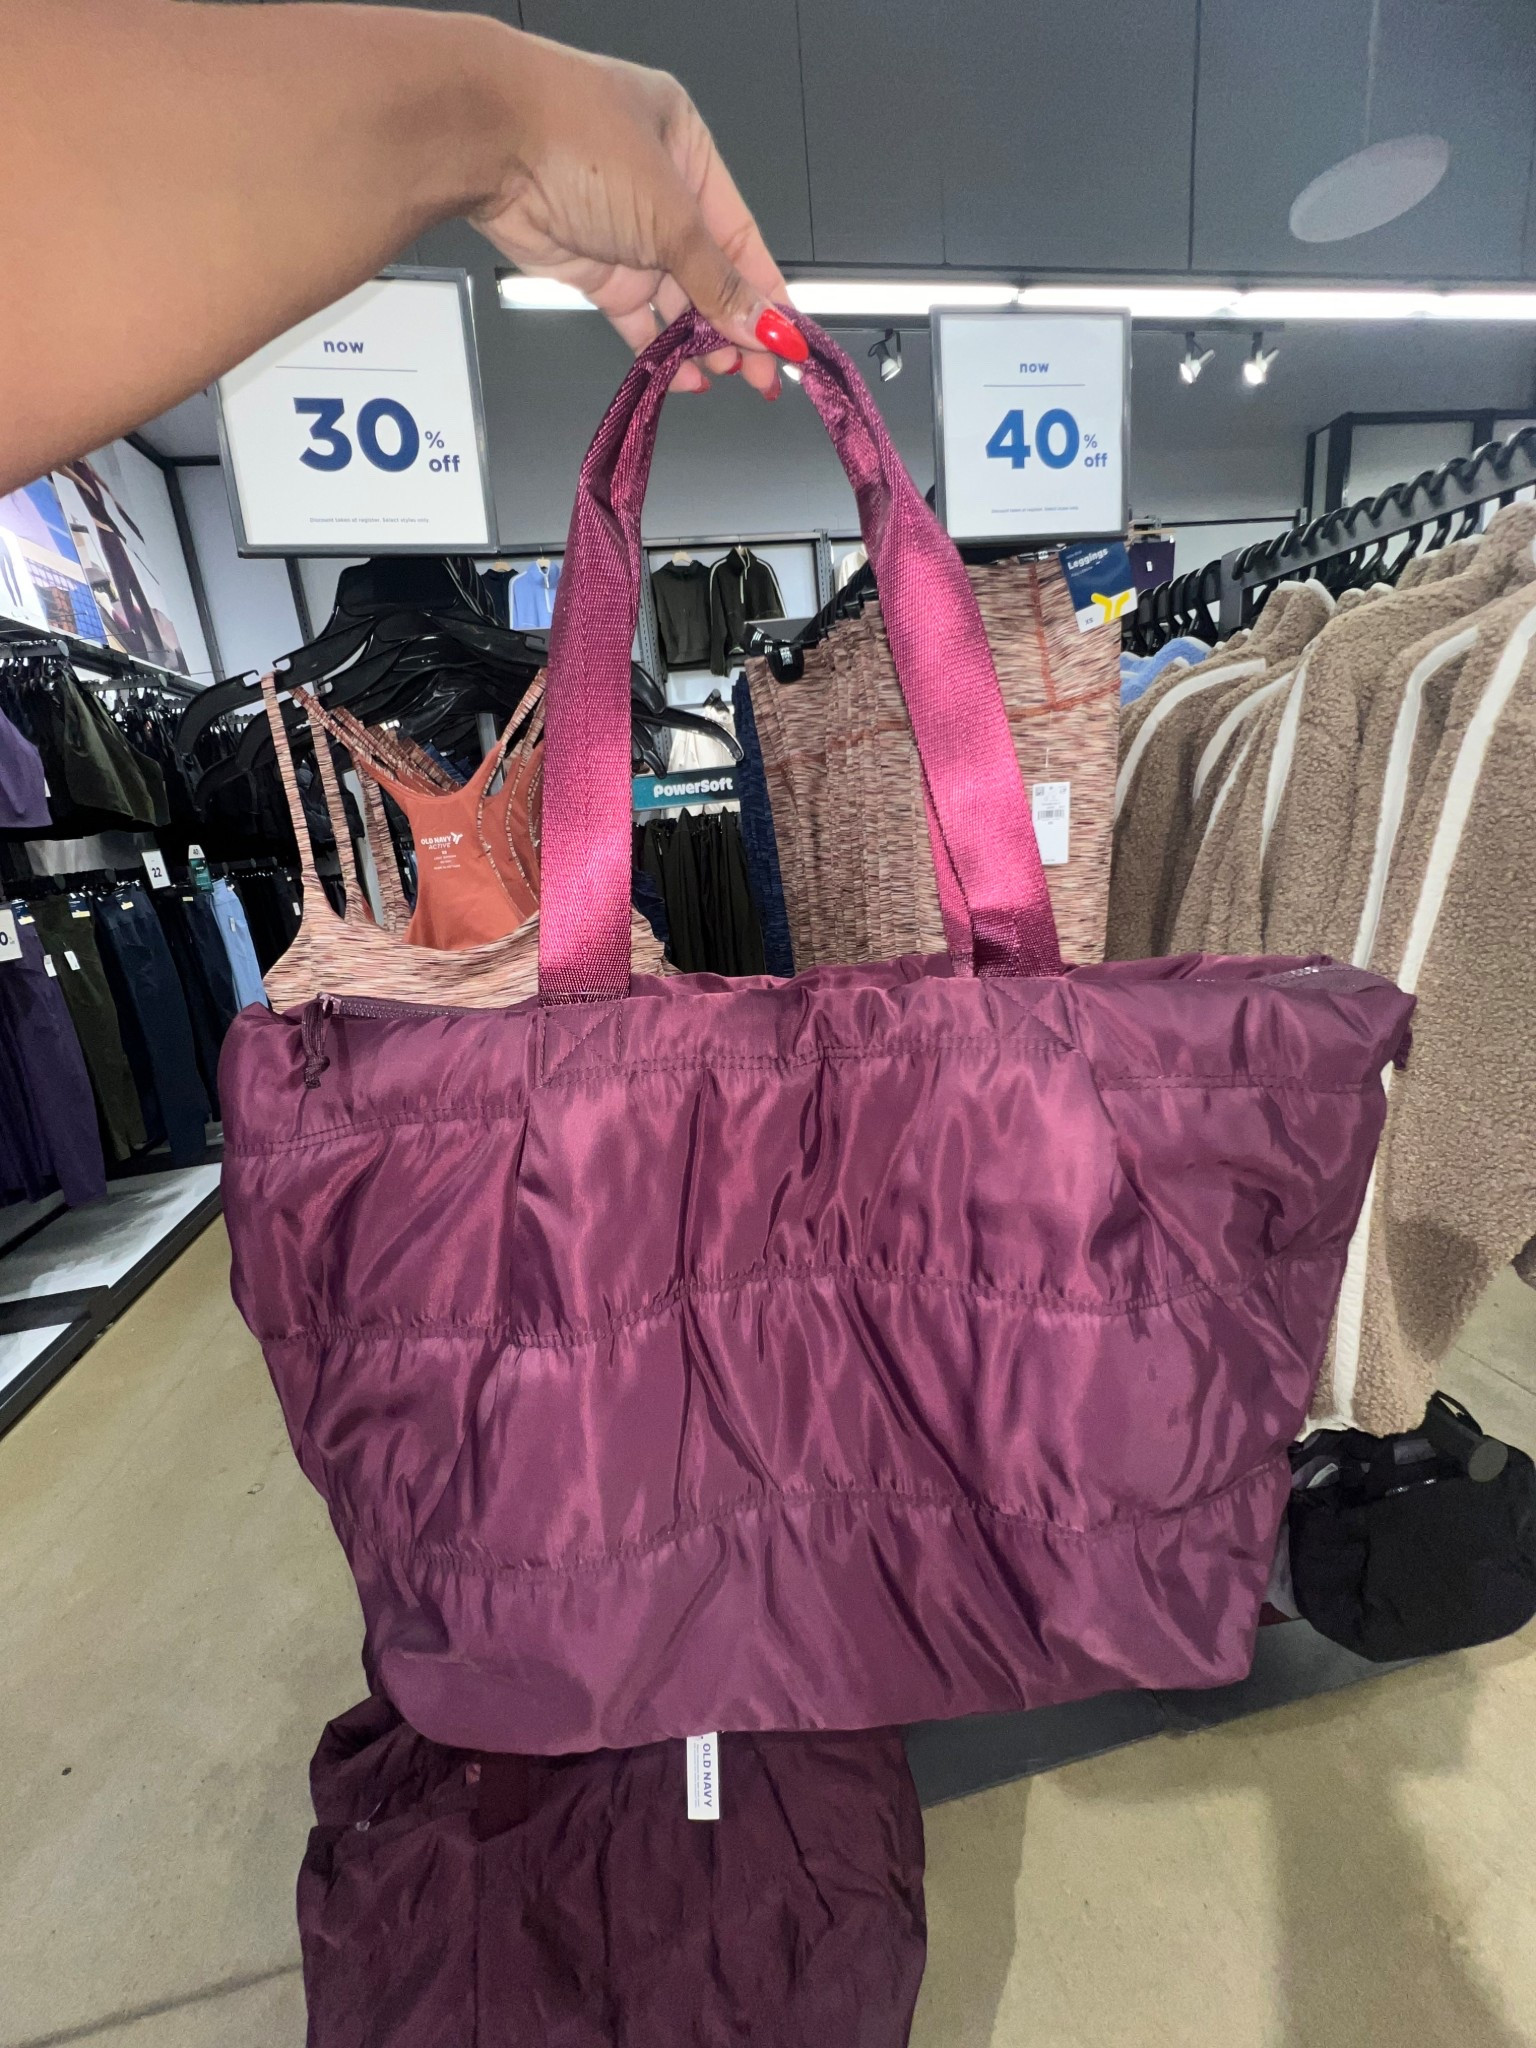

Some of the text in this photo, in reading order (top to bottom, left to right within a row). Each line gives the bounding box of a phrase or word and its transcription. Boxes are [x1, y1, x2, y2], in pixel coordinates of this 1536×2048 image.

[323, 339, 365, 354] now
[1019, 361, 1049, 374] now
[292, 397, 420, 473] 30
[985, 407, 1080, 470] 40
[428, 454, 461, 473] off
[1083, 453, 1108, 468] off
[1067, 548, 1109, 570] Leggings
[428, 842, 451, 850] ACTIVE
[151, 867, 163, 878] 22
[702, 1743, 712, 1808] OLD NAVY
